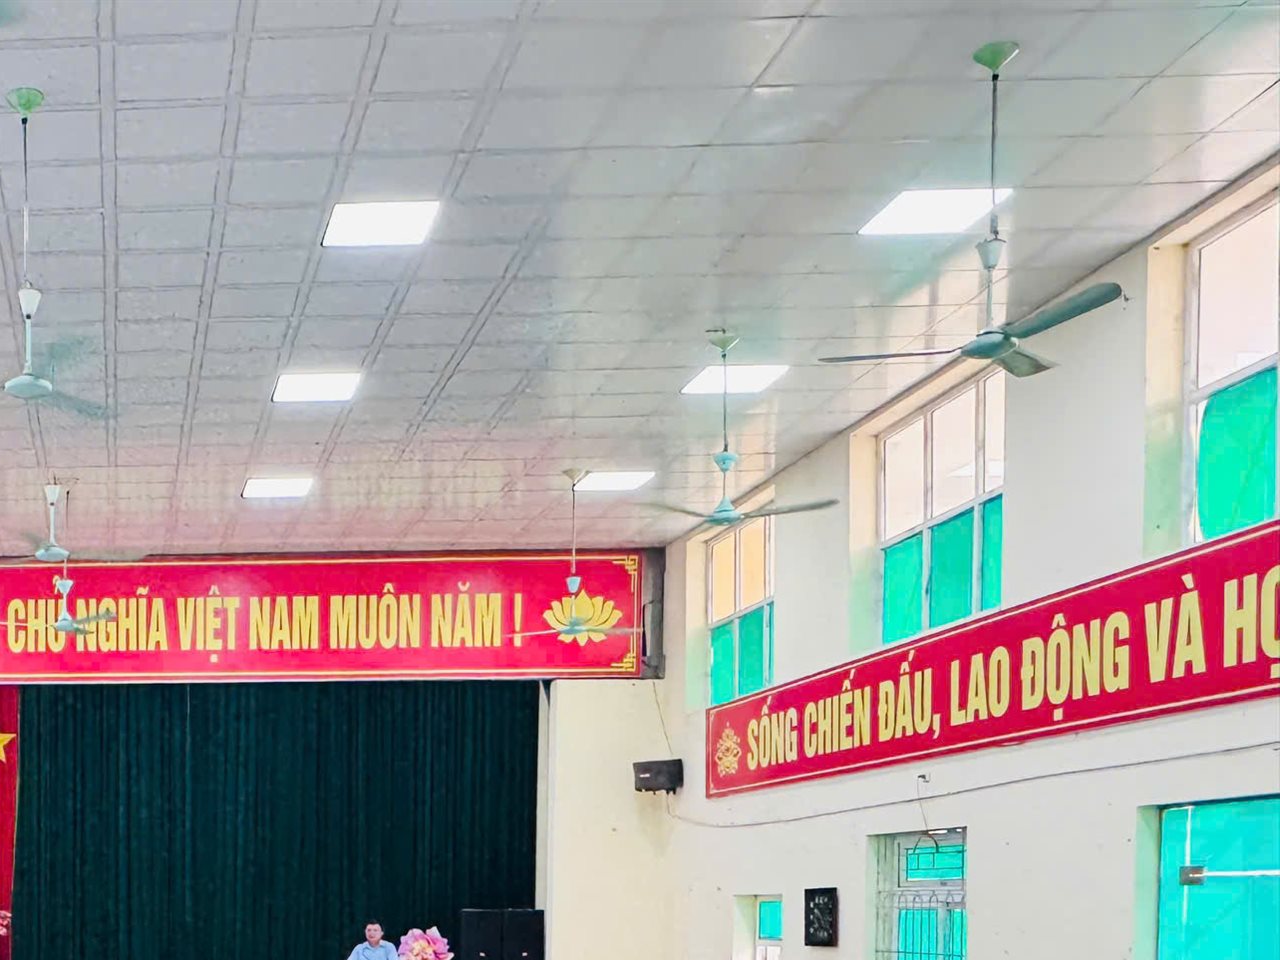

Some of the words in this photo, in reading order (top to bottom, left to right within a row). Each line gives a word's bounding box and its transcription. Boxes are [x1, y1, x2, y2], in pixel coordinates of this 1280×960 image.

[7, 575, 66, 653] CHỦ
[76, 586, 168, 652] NGHĨA
[177, 585, 240, 663] VIỆT
[249, 595, 319, 650] NAM
[330, 583, 420, 649] MUÔN
[431, 582, 503, 647] NĂM
[746, 695, 798, 770] SỐNG
[803, 668, 871, 758] CHIẾN
[877, 649, 940, 742] ĐẤU,
[951, 645, 1010, 726] LAO
[1021, 613, 1130, 720] ĐỘNG
[1144, 572, 1206, 683] VÀ
